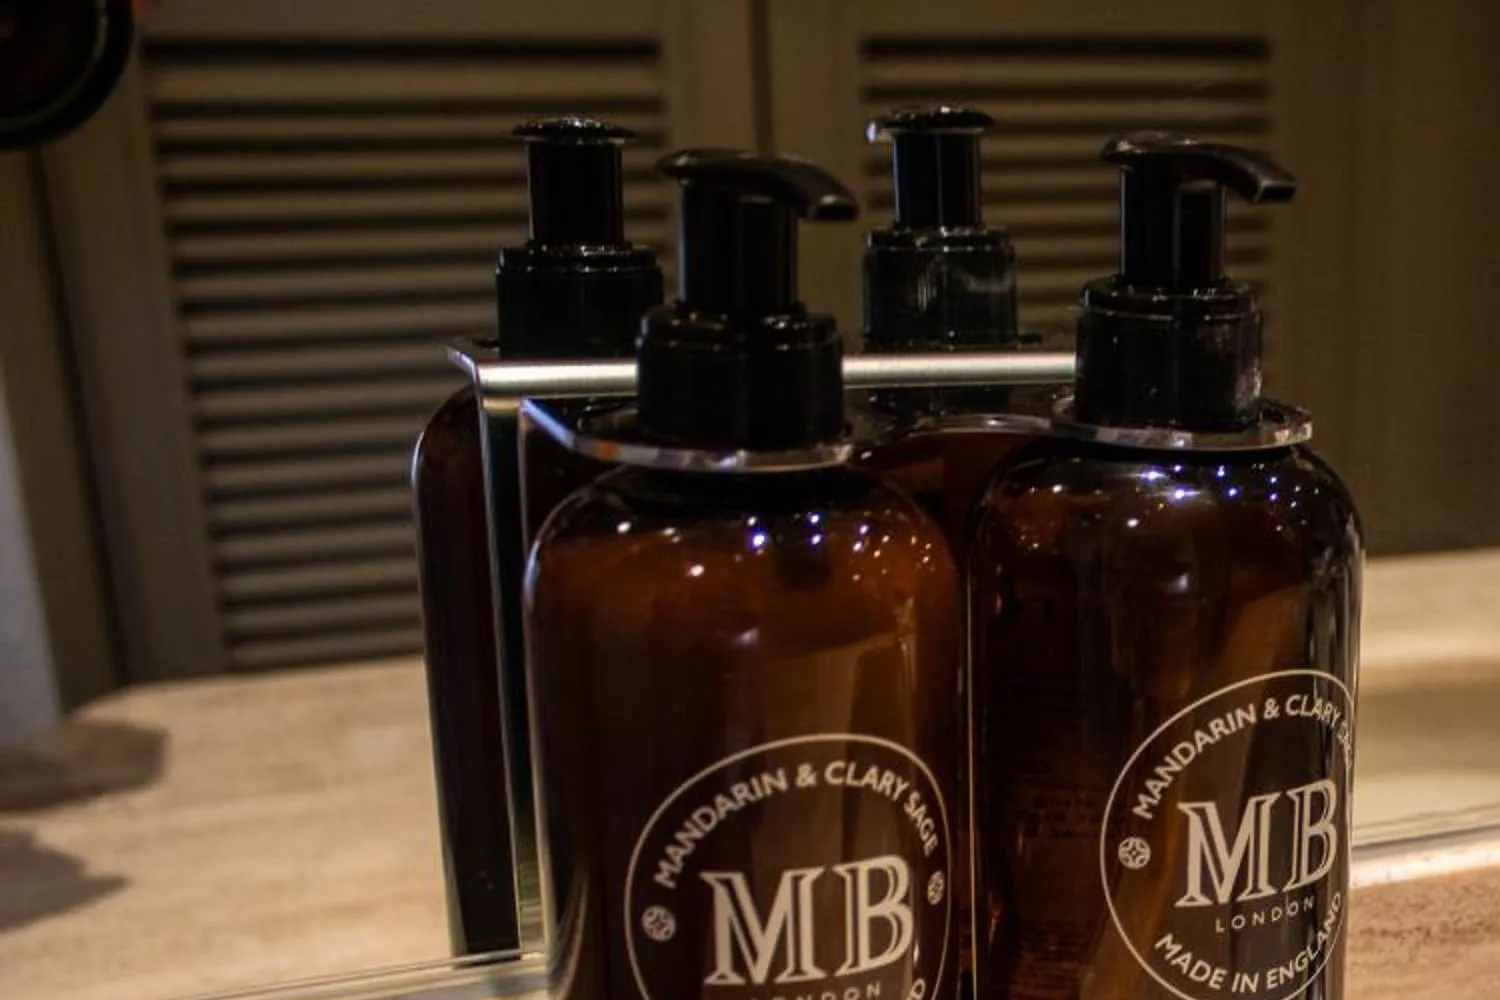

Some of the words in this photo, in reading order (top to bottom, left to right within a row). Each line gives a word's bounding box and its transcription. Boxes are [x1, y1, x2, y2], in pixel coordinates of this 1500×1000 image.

[1132, 703, 1257, 821] MANDARIN
[1263, 697, 1281, 720] &
[1284, 693, 1341, 730] CLARY
[653, 767, 788, 890] MANDARIN
[796, 762, 817, 787] &
[824, 760, 907, 801] CLARY
[903, 791, 939, 857] SAGE
[1174, 778, 1338, 908] MB
[699, 854, 914, 986] MB
[1155, 933, 1225, 990] MADE
[1231, 971, 1260, 994] IN
[1266, 891, 1341, 990] ENGLAND
[1215, 896, 1314, 933] LONDON
